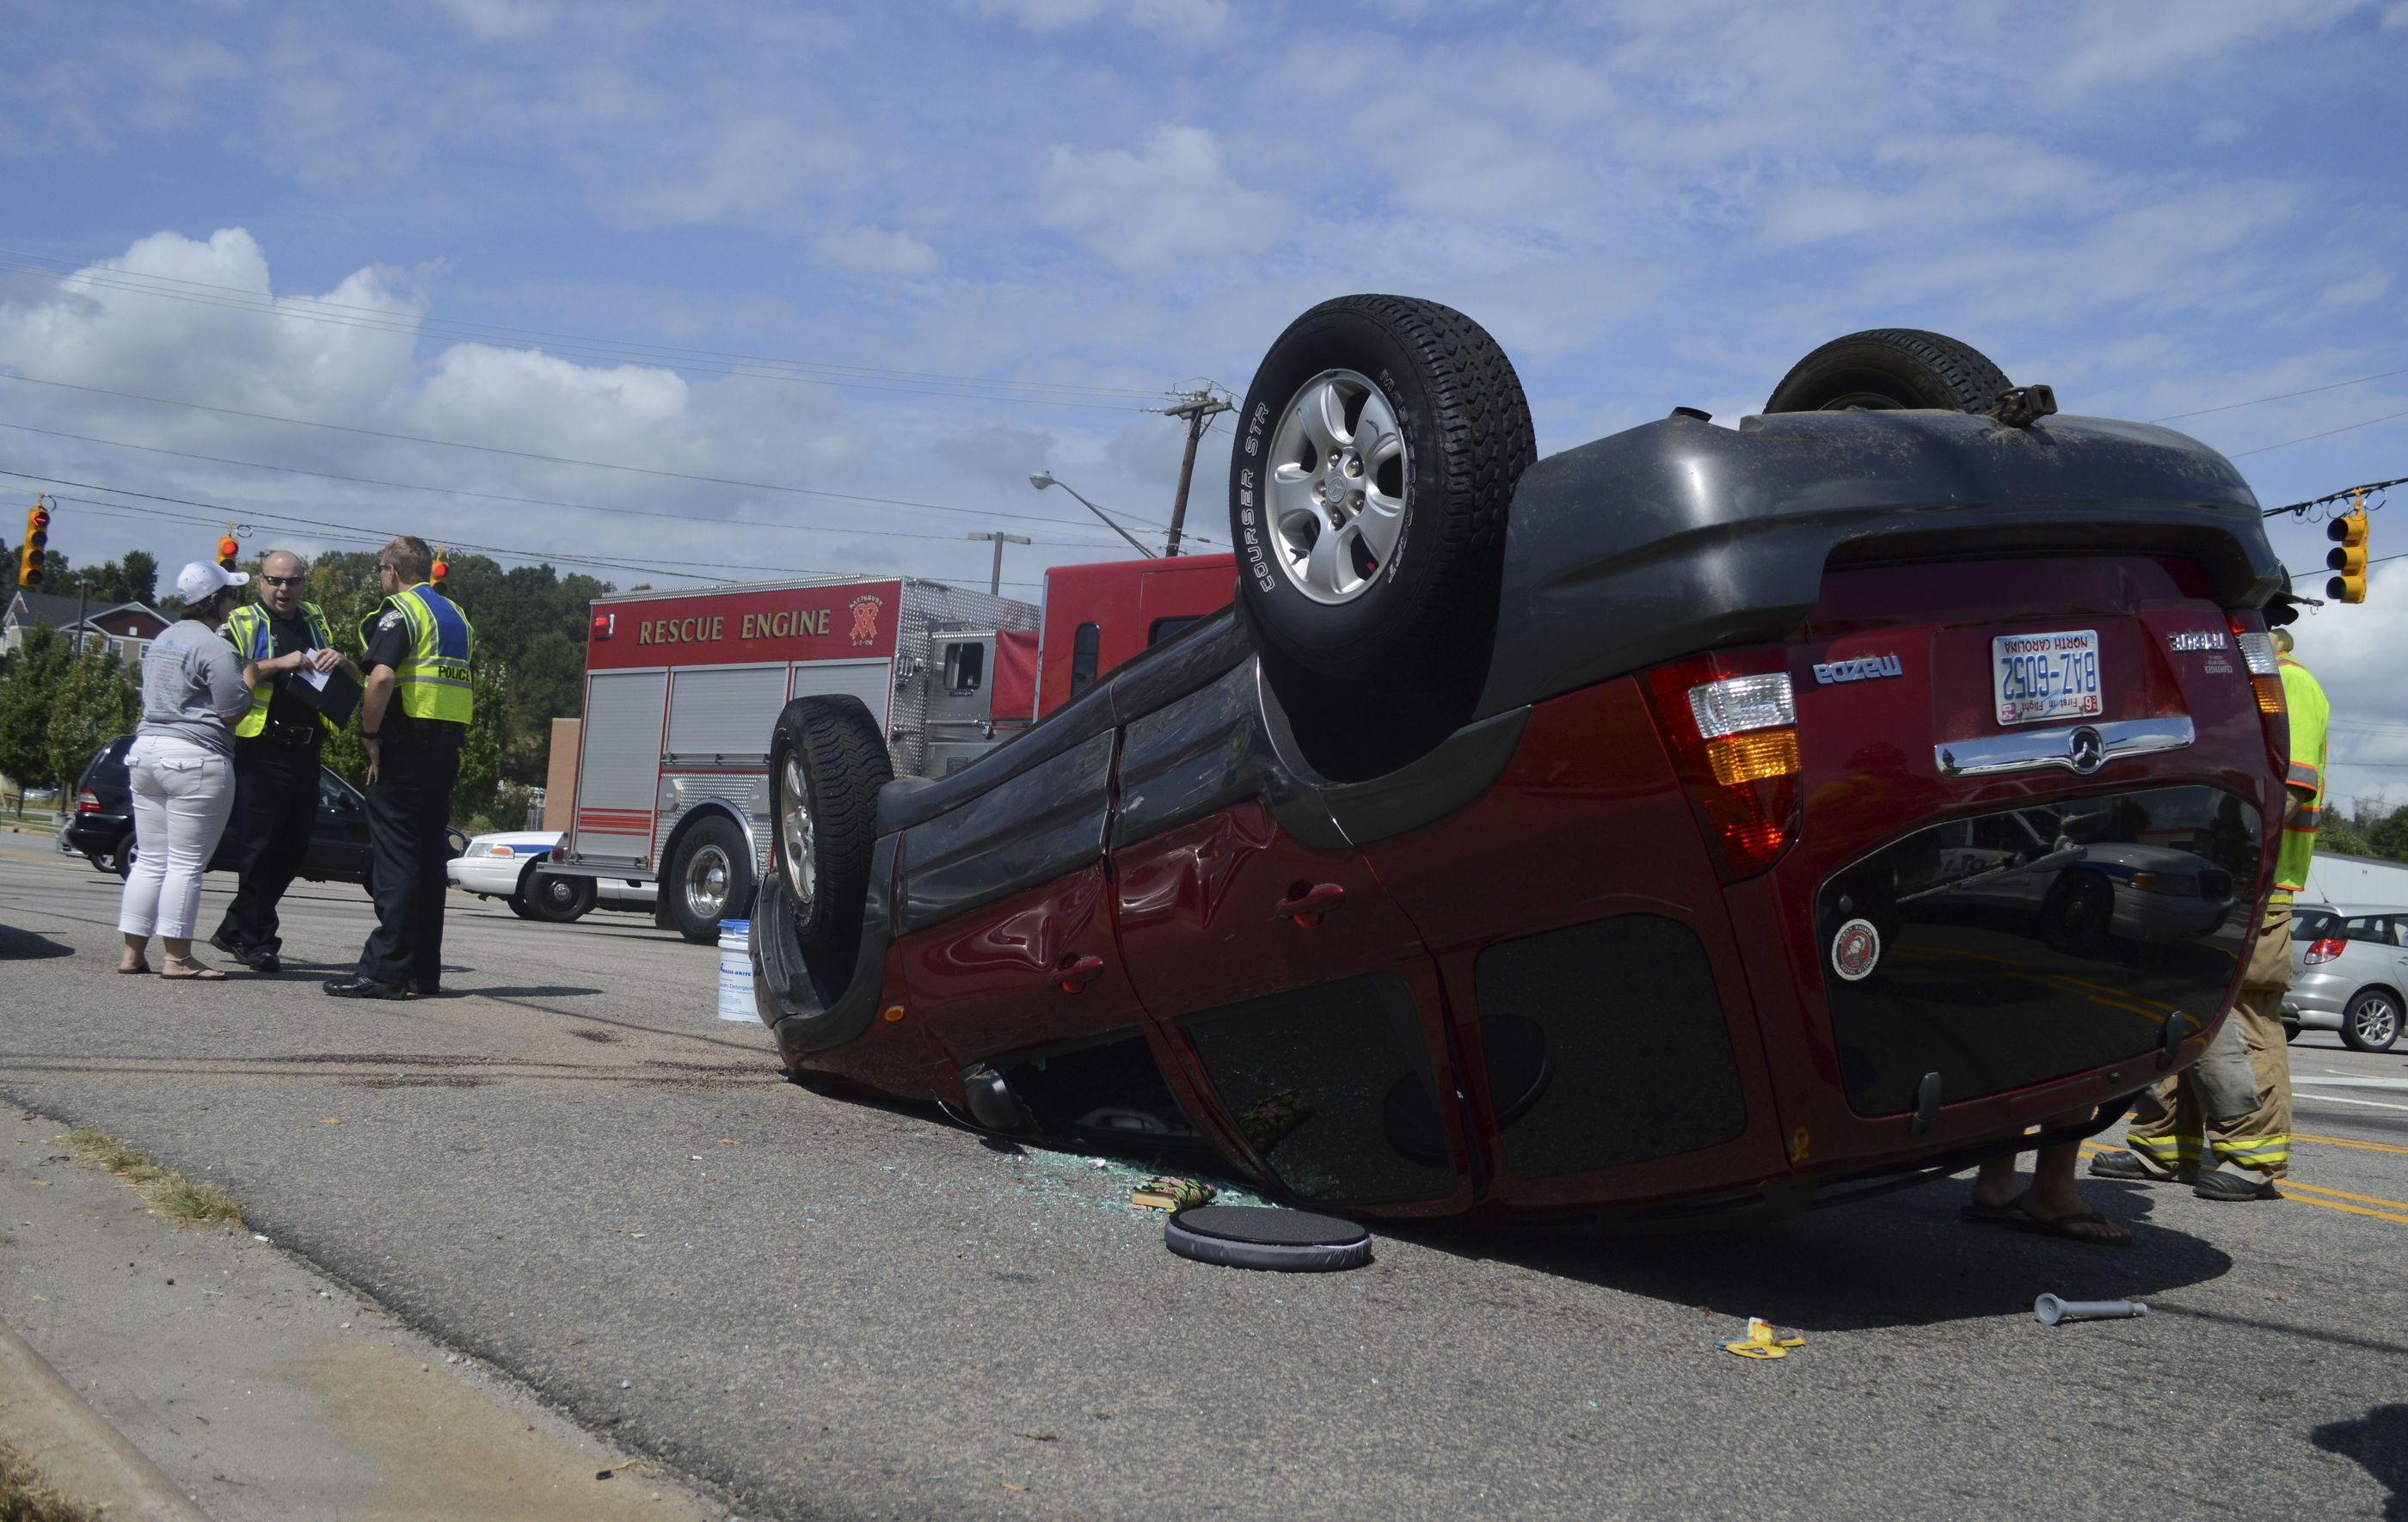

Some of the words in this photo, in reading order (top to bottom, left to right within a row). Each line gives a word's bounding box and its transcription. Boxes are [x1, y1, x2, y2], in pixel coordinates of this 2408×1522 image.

[1245, 402, 1270, 457] STR
[1241, 469, 1275, 592] COURSER
[639, 616, 724, 645] RESCUE
[740, 609, 831, 641] ENGINE
[2004, 639, 2051, 654] CAROLINA
[2055, 636, 2088, 650] NORTH
[438, 665, 470, 682] POLICE
[2001, 651, 2097, 700] BAZ-6052
[2021, 701, 2043, 713] Flight
[2061, 697, 2078, 709] First
